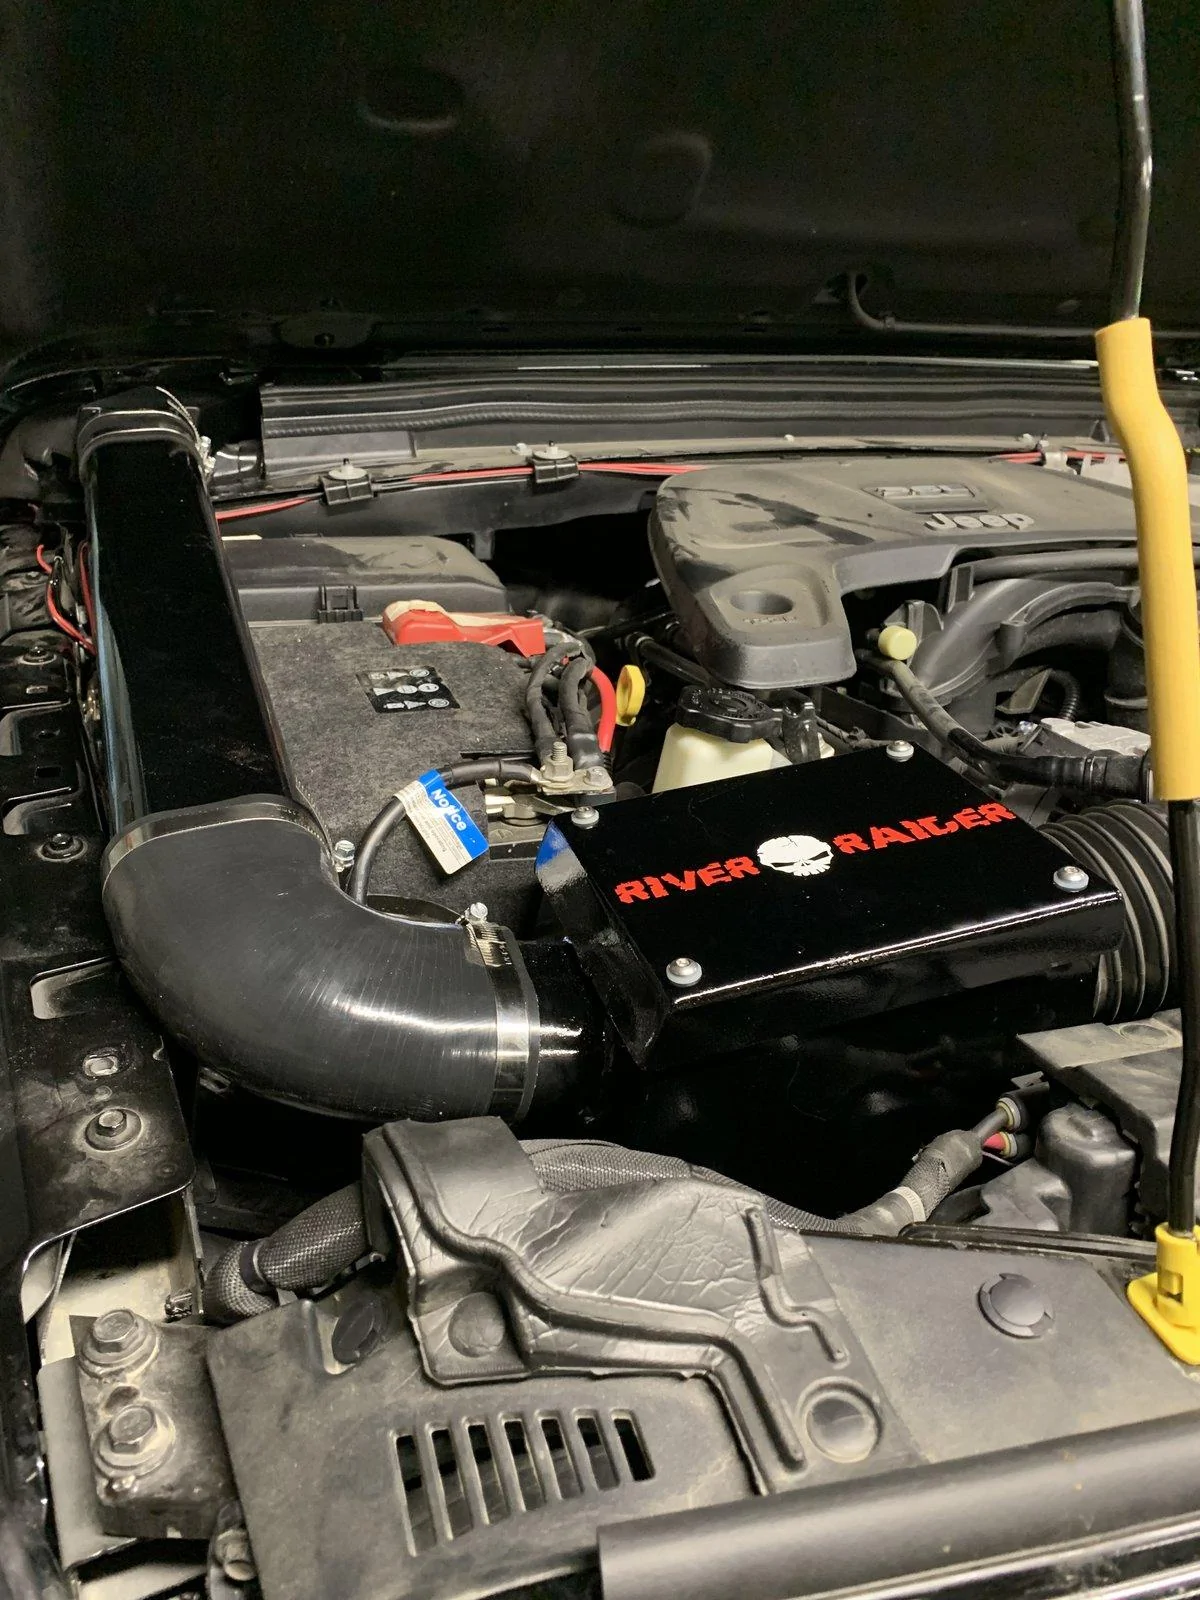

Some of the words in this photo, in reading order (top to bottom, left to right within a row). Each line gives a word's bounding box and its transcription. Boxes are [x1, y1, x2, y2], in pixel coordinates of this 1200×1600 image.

[924, 513, 1035, 530] Jeep
[430, 788, 467, 831] Notice
[614, 856, 760, 904] RIVER
[832, 802, 1016, 854] RAIDER
